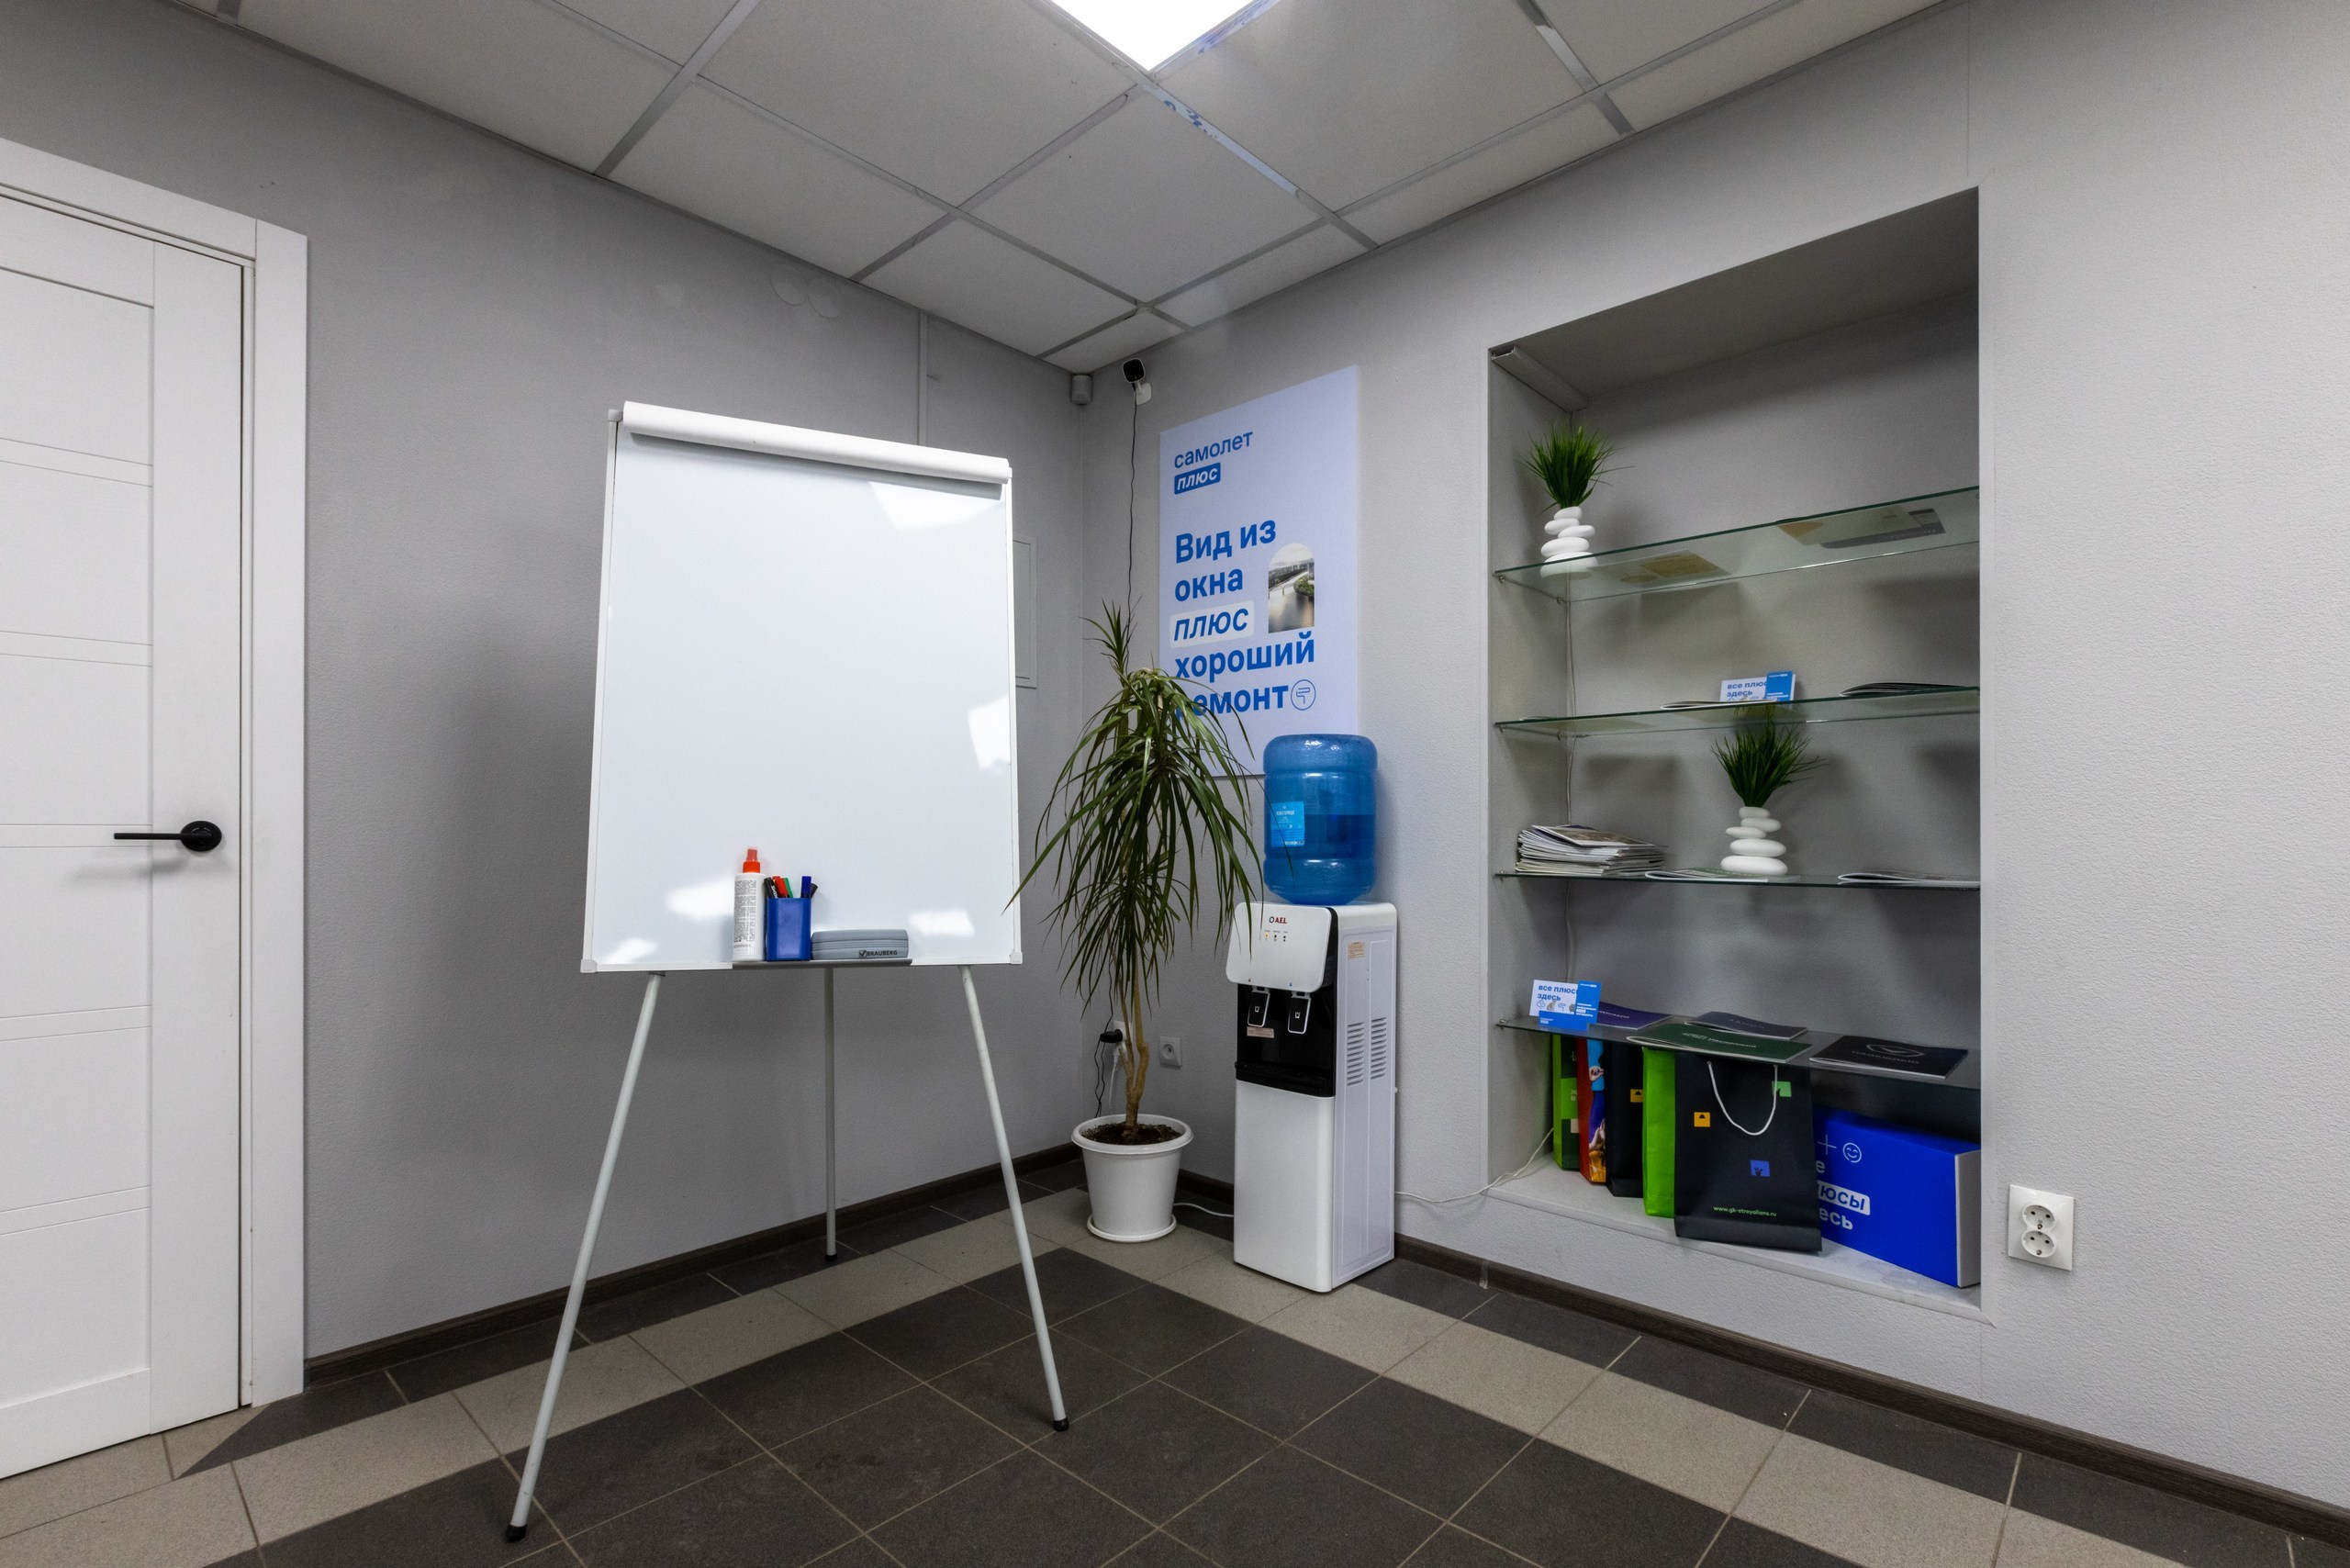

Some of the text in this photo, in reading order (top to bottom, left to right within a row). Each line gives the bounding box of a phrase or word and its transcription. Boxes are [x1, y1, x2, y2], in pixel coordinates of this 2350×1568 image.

[1174, 431, 1254, 469] самолет
[1177, 467, 1218, 491] плюс
[1176, 520, 1277, 564] Вид из
[1175, 568, 1243, 602] окна
[1174, 608, 1249, 641] плюс
[1175, 631, 1315, 683] хороший
[1176, 685, 1289, 721] емонт
[1538, 984, 1578, 994] все плюс
[1818, 1184, 1866, 1211] юсы
[1818, 1207, 1853, 1230] есь
